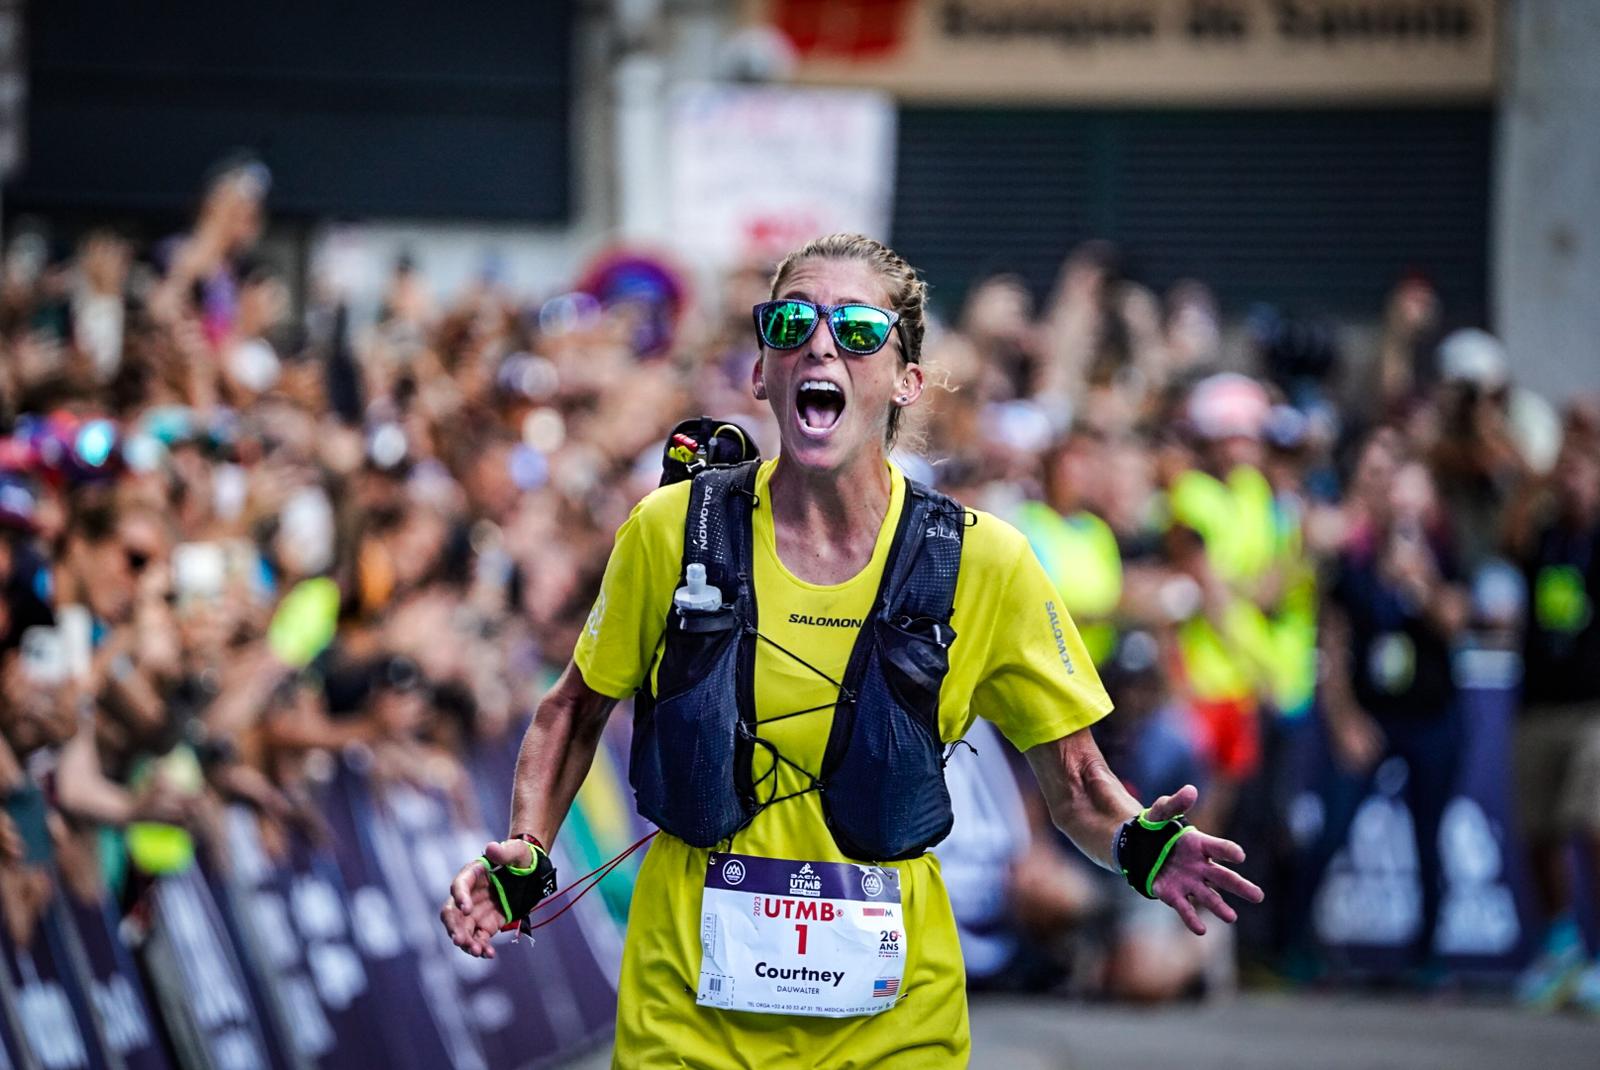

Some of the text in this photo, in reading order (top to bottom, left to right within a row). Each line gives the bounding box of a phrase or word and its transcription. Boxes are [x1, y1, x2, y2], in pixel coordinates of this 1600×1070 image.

[700, 485, 713, 551] SALOMON
[788, 613, 863, 629] SALOMON
[1045, 601, 1075, 675] SALOMON
[789, 879, 821, 890] UTMB
[753, 896, 762, 917] 2023
[795, 924, 808, 954] 1
[880, 930, 899, 942] 20
[879, 943, 899, 951] ANS
[755, 961, 846, 987] Courtney
[776, 985, 820, 994] DAUWALTER
